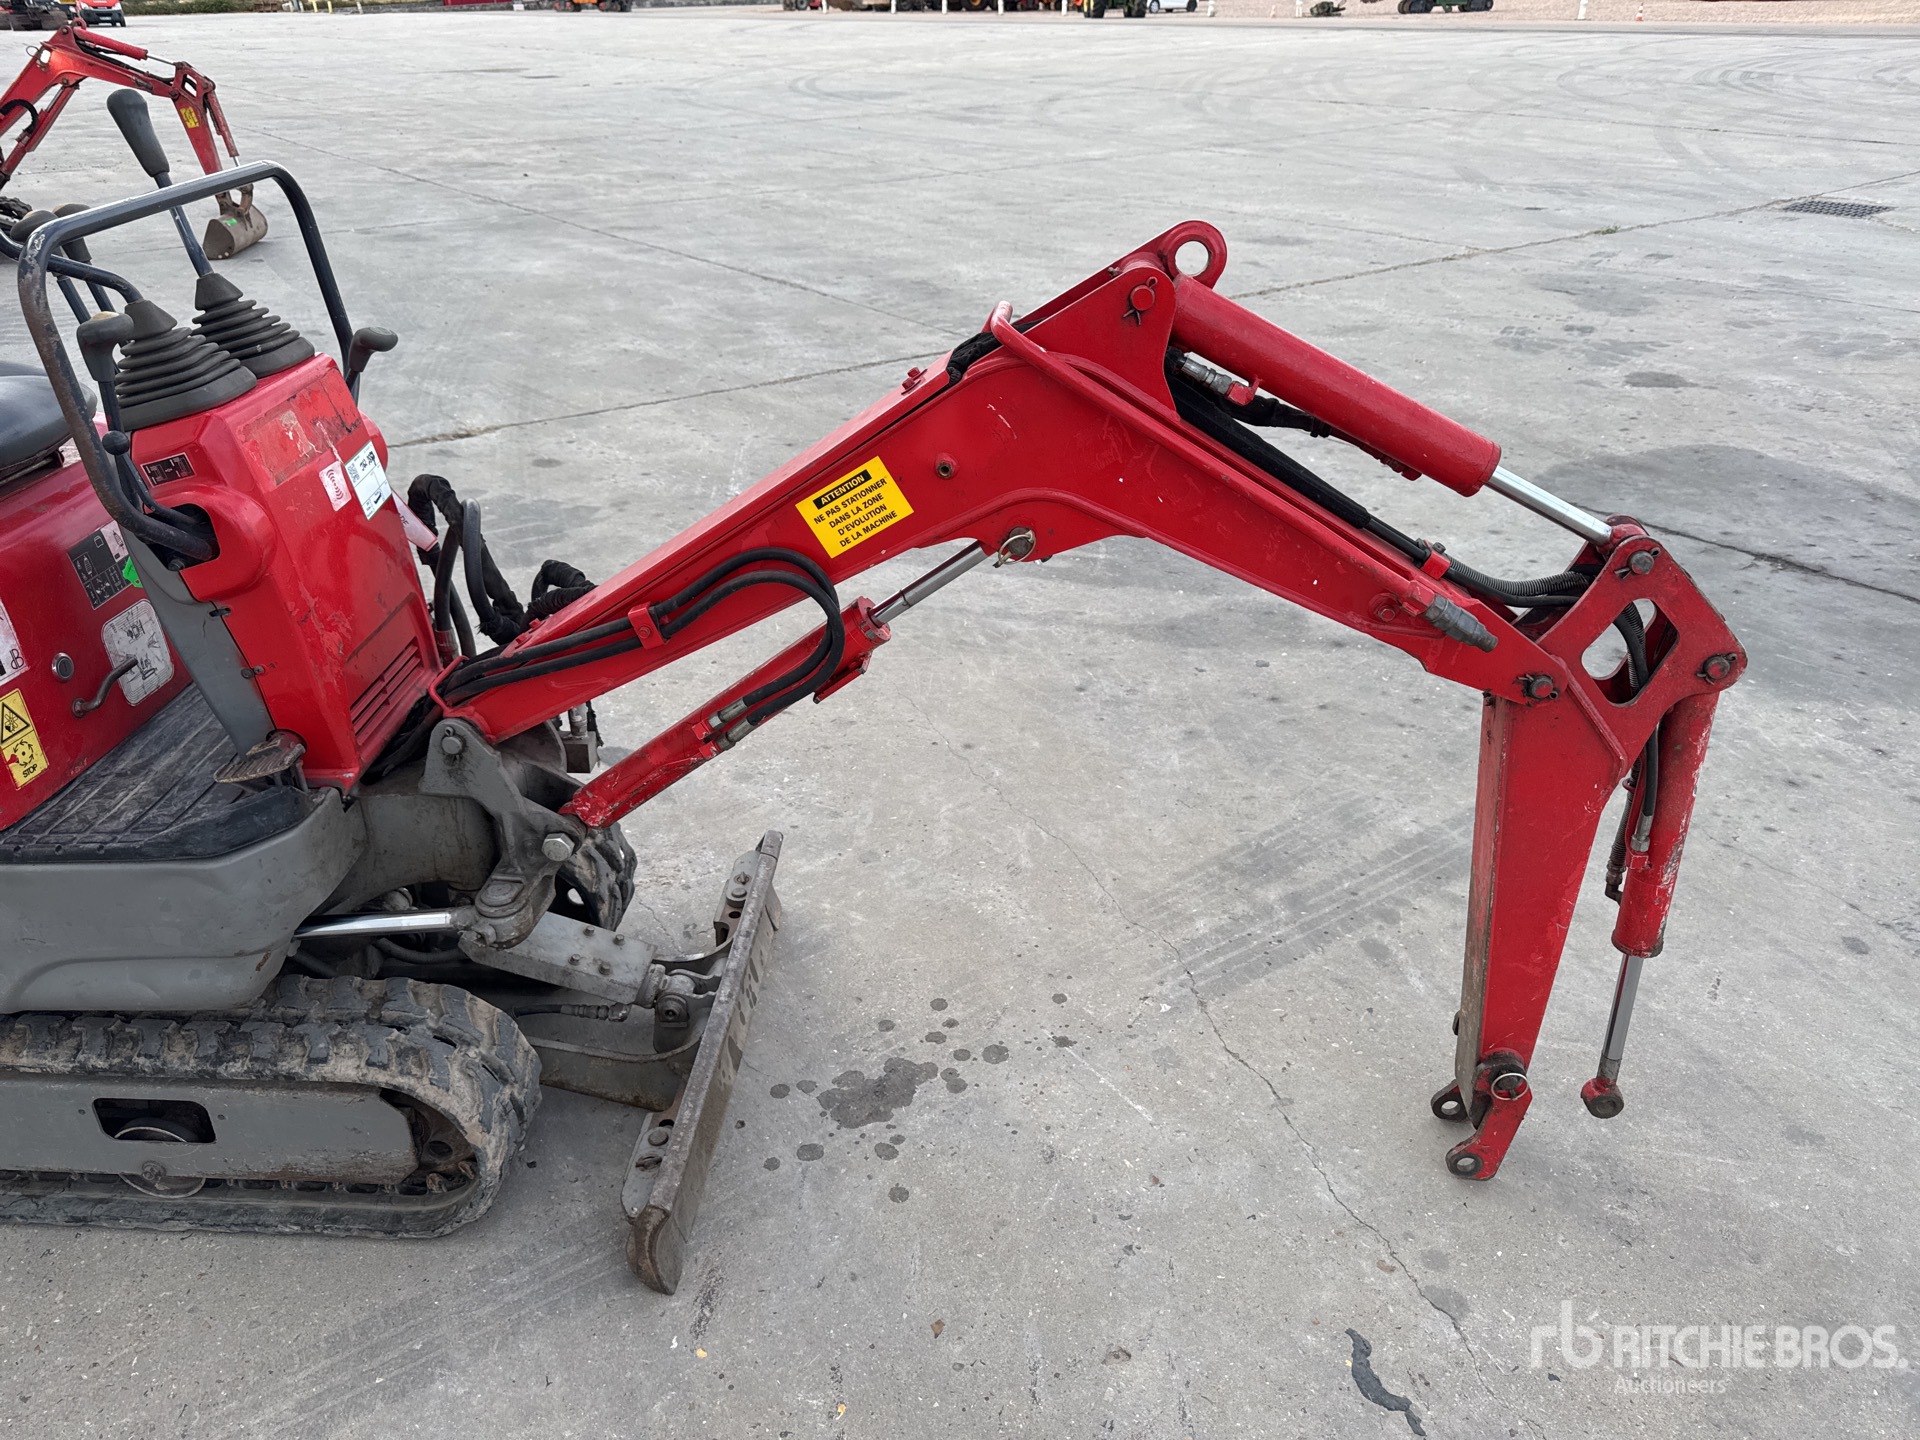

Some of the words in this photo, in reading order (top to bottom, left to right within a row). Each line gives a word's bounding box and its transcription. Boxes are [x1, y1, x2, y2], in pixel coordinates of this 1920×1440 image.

[813, 513, 826, 525] NE
[825, 506, 842, 518] PAS
[841, 478, 887, 509] STATIONNER
[820, 474, 865, 505] ATTENTION
[828, 513, 851, 528] DANS
[850, 507, 862, 516] LA
[862, 492, 884, 509] ZONE
[837, 503, 887, 536] D'EVOLUTION
[839, 537, 852, 547] DE
[851, 531, 863, 541] LA
[862, 510, 898, 535] MACHINE
[22, 763, 38, 777] STOP
